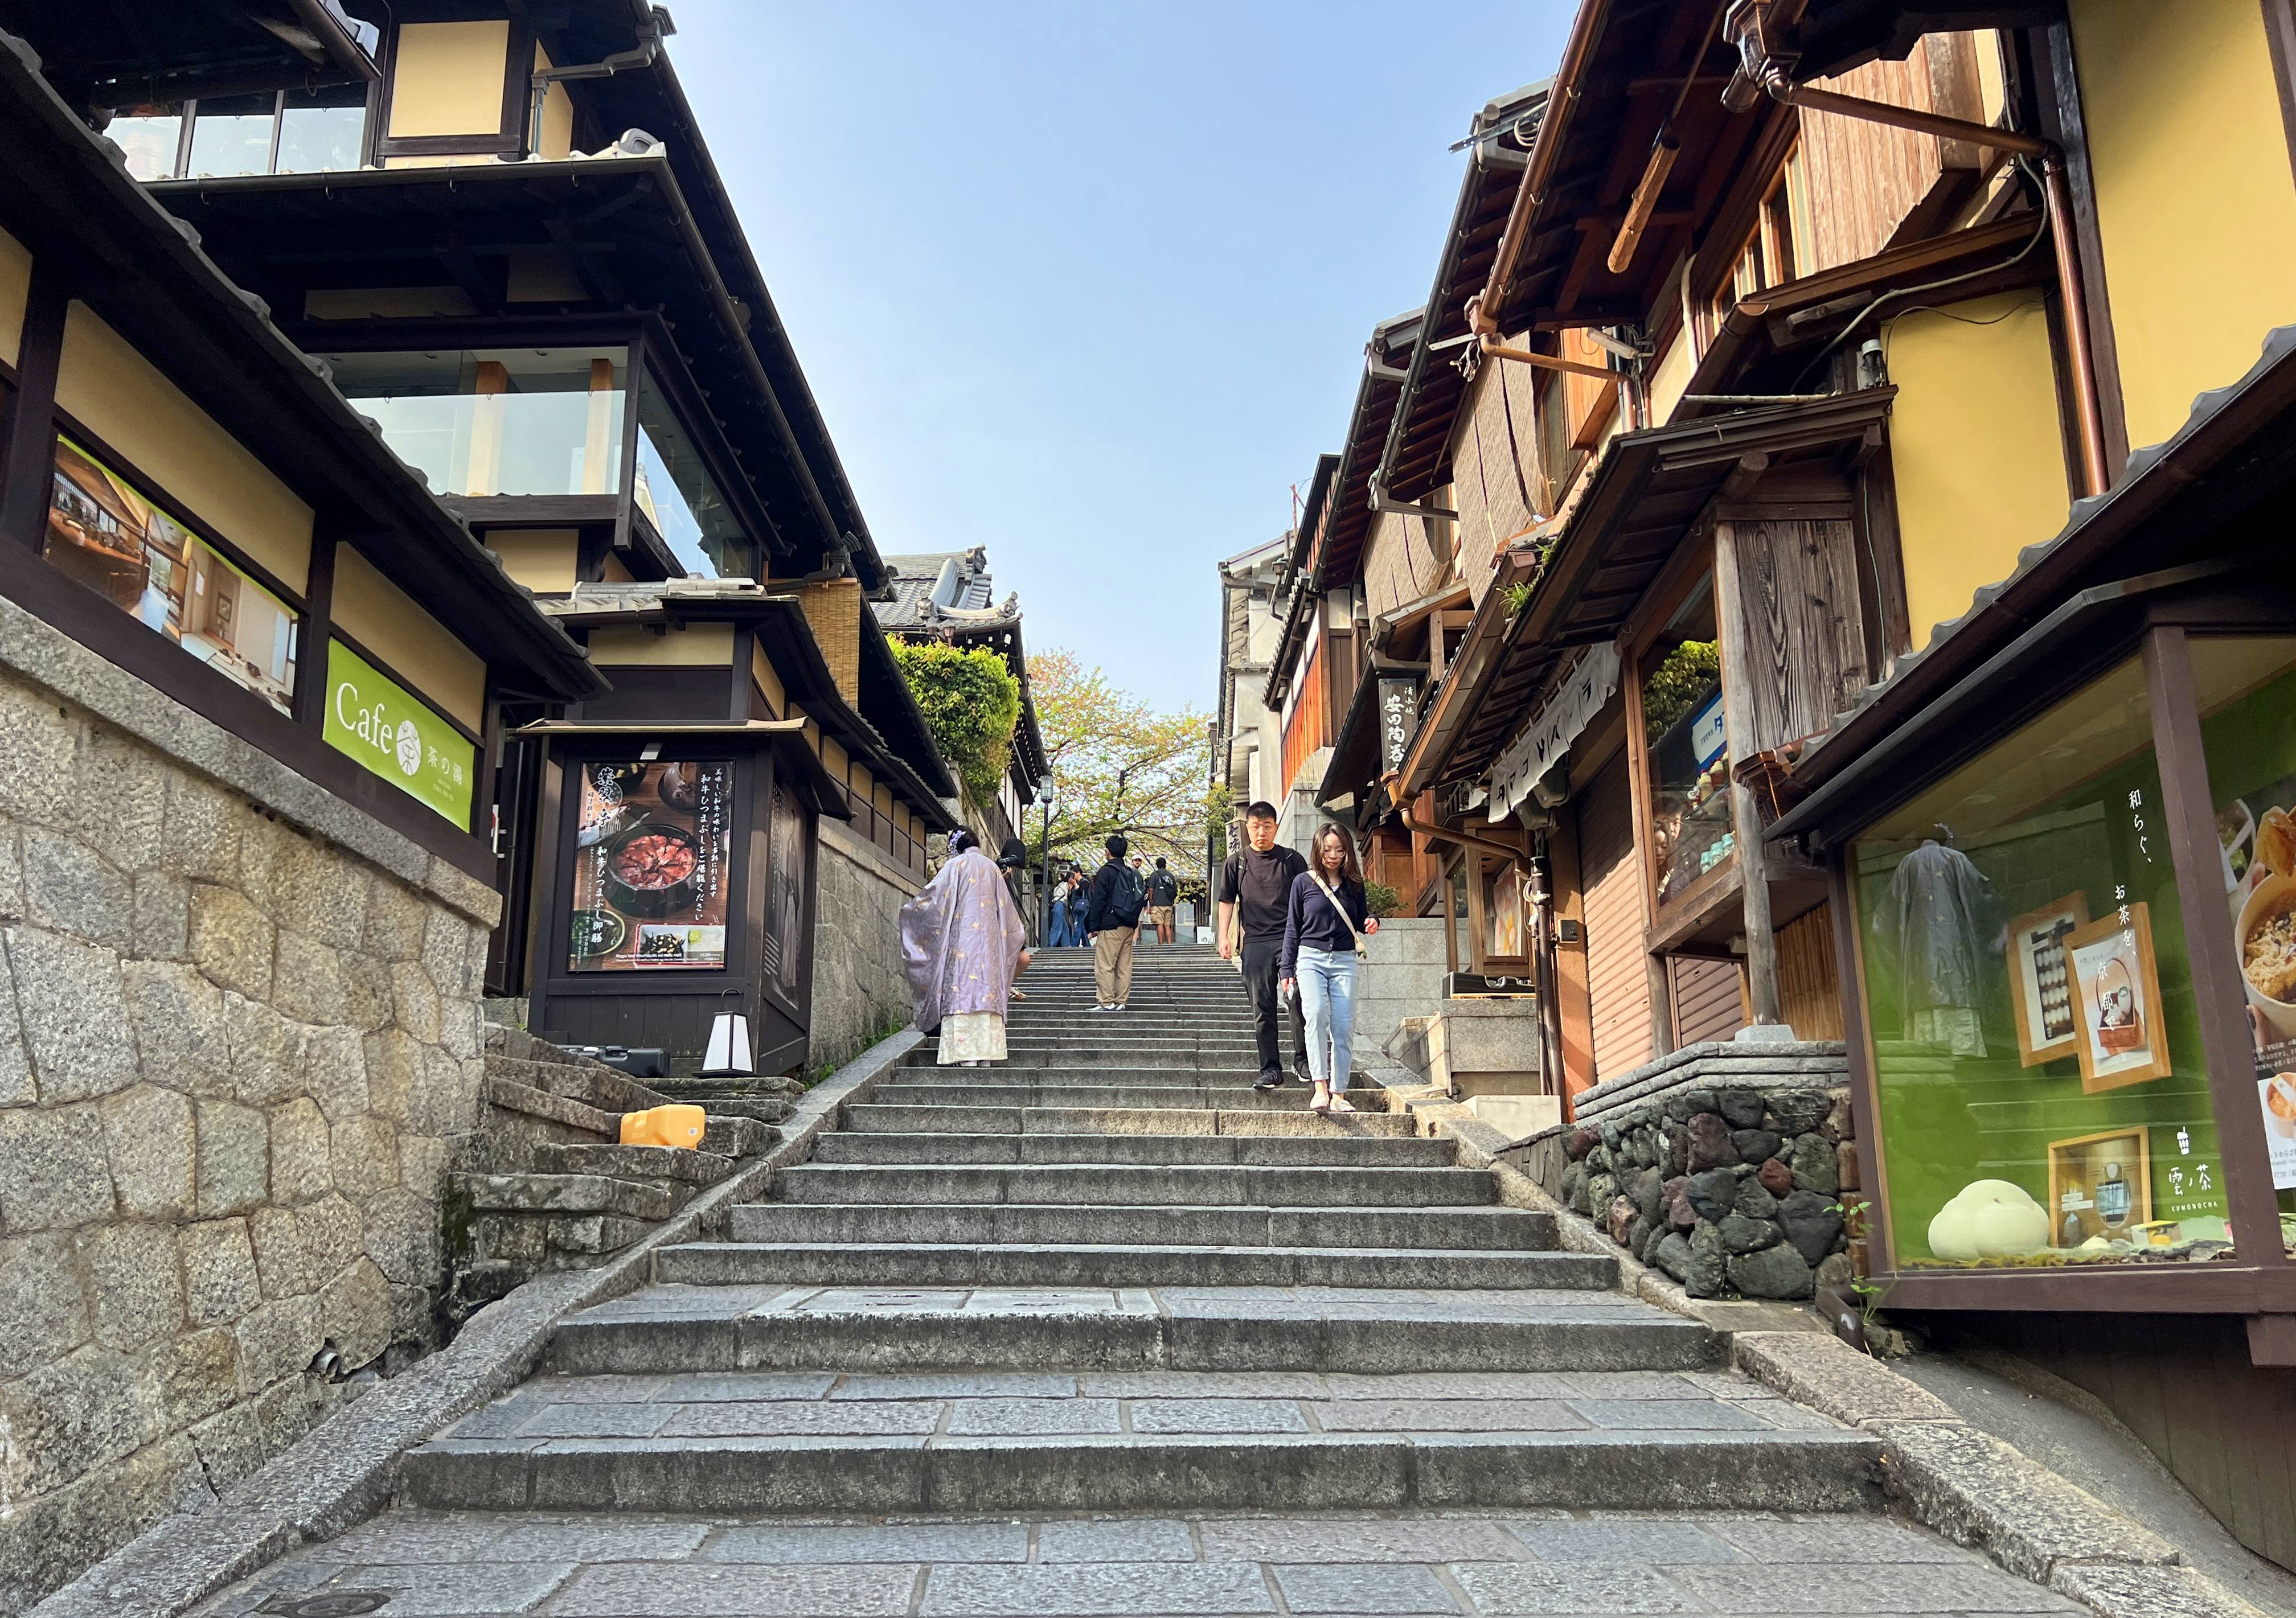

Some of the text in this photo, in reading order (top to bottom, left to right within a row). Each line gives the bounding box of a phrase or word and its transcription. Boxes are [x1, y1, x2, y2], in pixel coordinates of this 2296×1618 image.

[337, 682, 392, 755] Cafe
[695, 774, 711, 921] 和牛ひつまぶしをご堪能ください
[591, 845, 607, 944] 和牛ひつまぶし御膳
[2097, 962, 2115, 1030] 京都で
[2168, 1164, 2212, 1196] 雲ノ茶
[2171, 1201, 2219, 1212] KUMONOCHA
